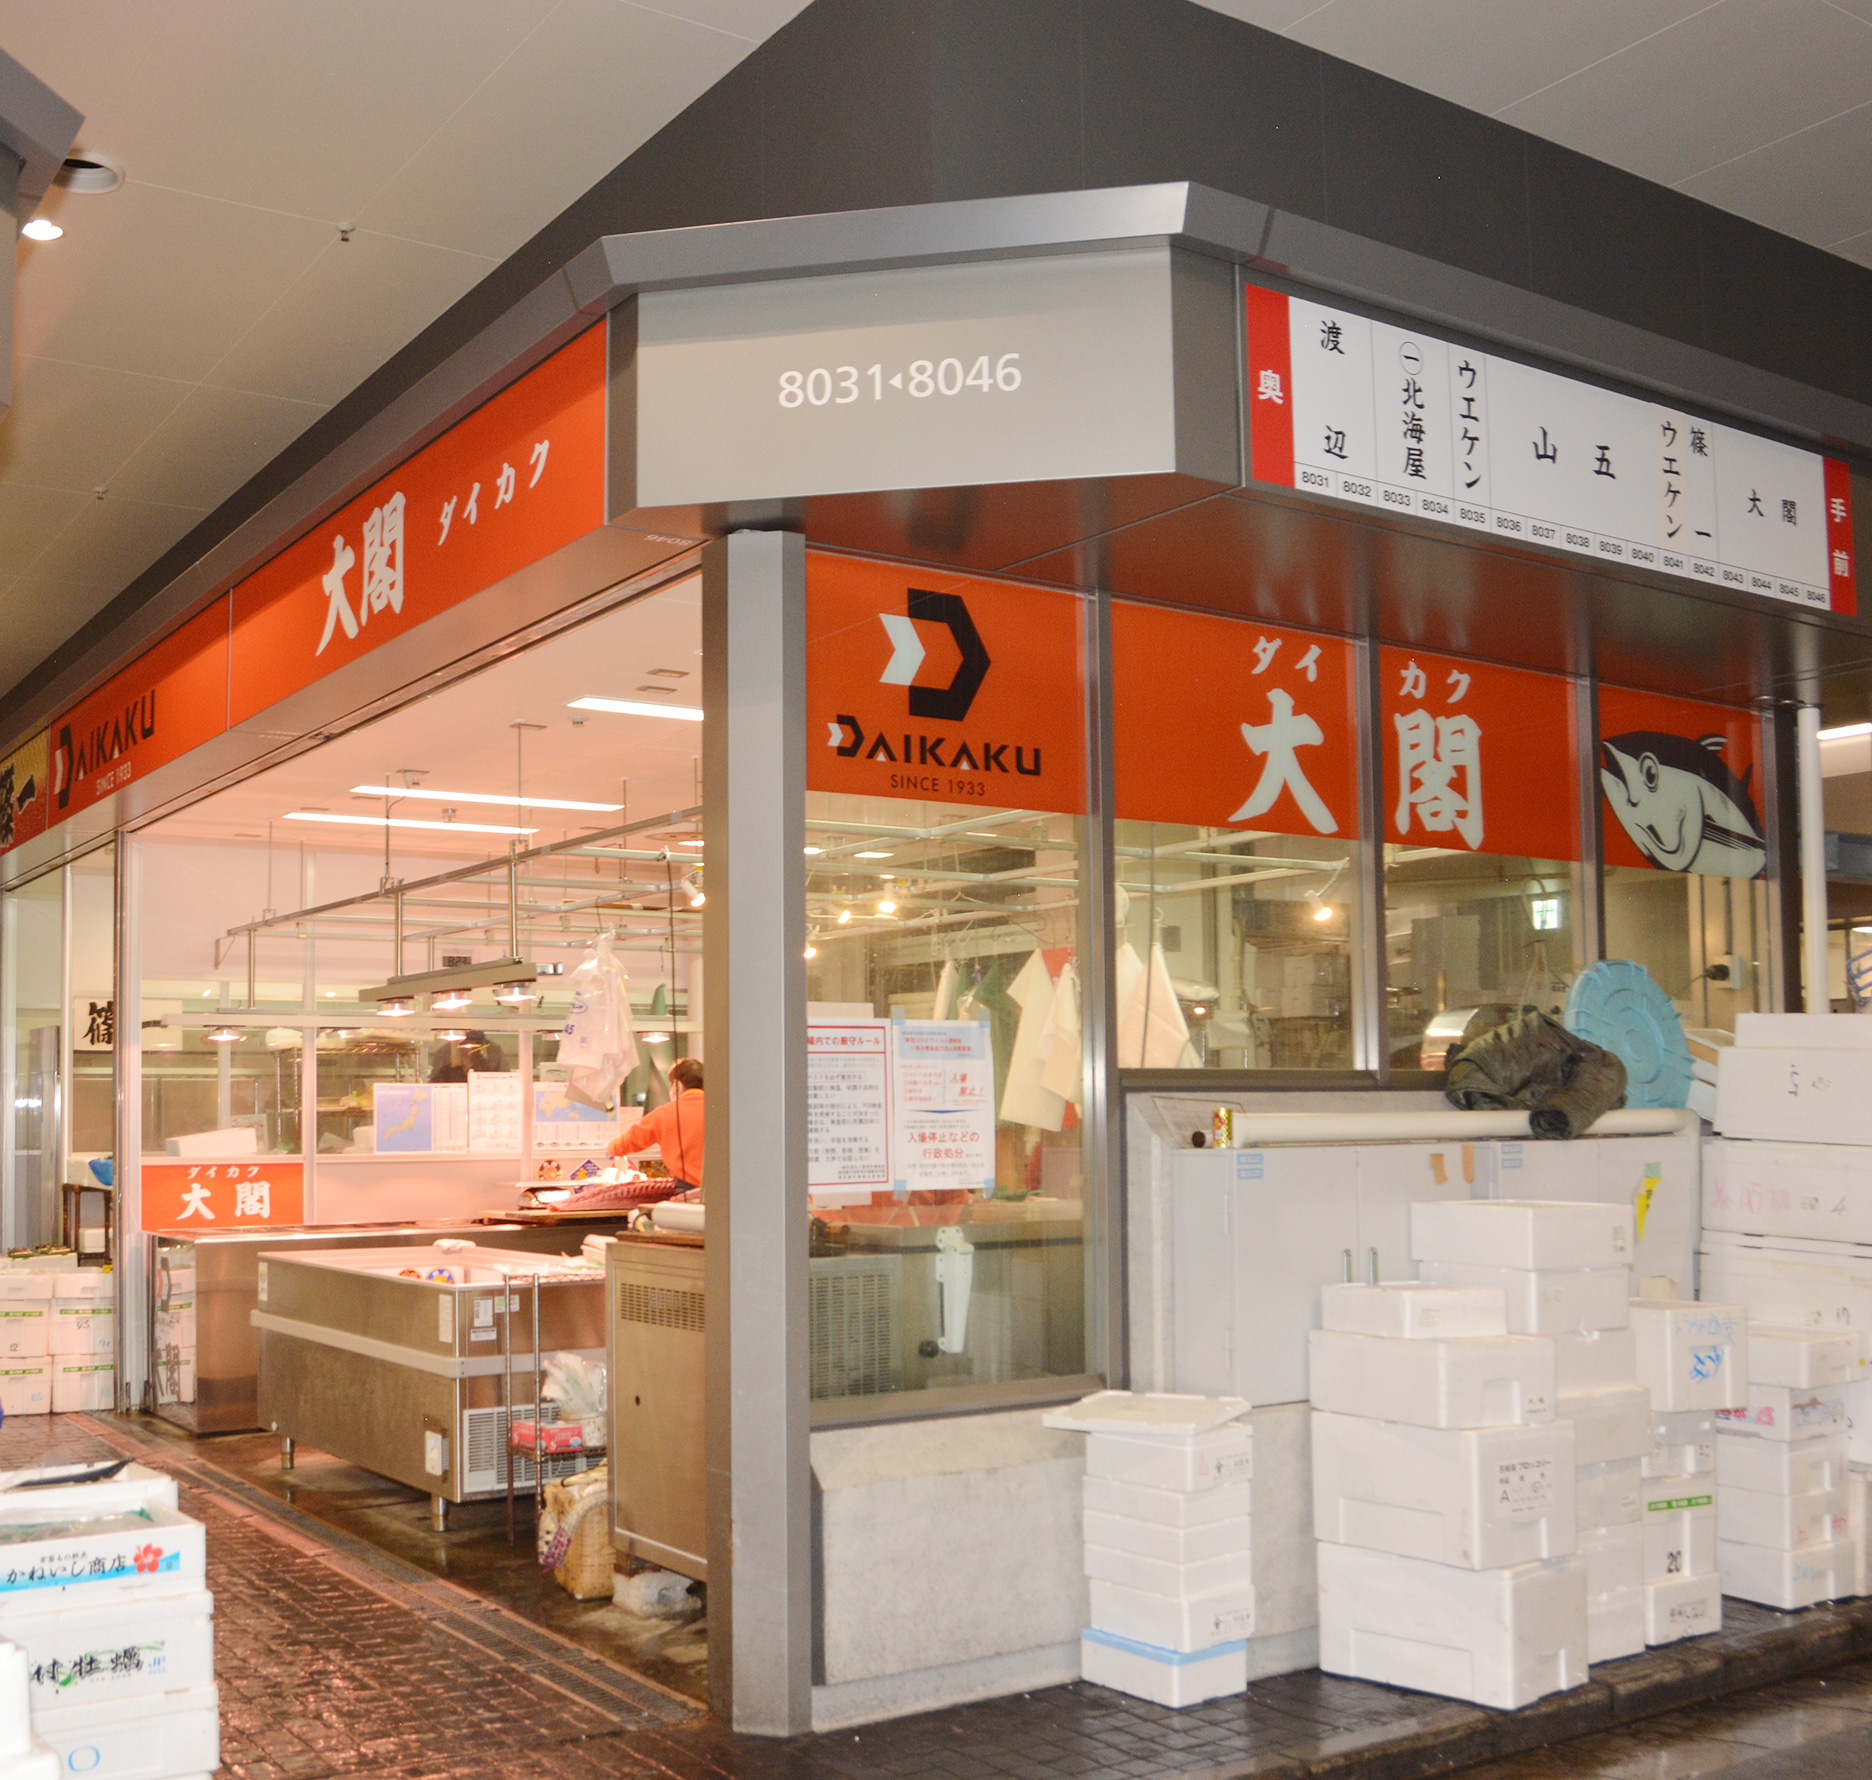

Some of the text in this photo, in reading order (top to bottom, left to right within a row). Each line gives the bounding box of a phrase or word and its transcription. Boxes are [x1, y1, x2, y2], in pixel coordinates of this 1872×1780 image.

[778, 352, 1023, 407] 8031 8046
[1257, 368, 1284, 405] 奥
[1320, 319, 1350, 460] 渡辺
[1458, 360, 1482, 490] ウエケン
[1661, 420, 1683, 539] ウエケン
[315, 439, 550, 657] 大閣 ダイカク
[1302, 471, 1826, 603] 8031 8032 8033 8034 8035 8036 8037 8038 8039 8040 8041 8042 8043 8044 8045 8046
[1830, 497, 1850, 578] 手前
[54, 688, 155, 811] DAIKAKU
[826, 714, 1042, 776] DAIKAKU
[96, 761, 131, 796] SINCE 1933
[890, 773, 987, 797] SINCE 1933
[907, 1131, 980, 1144] 入場停止などの
[922, 1147, 965, 1160] 行政処分
[188, 1165, 260, 1179] ダイカク
[7, 1554, 127, 1585] かねいし商店
